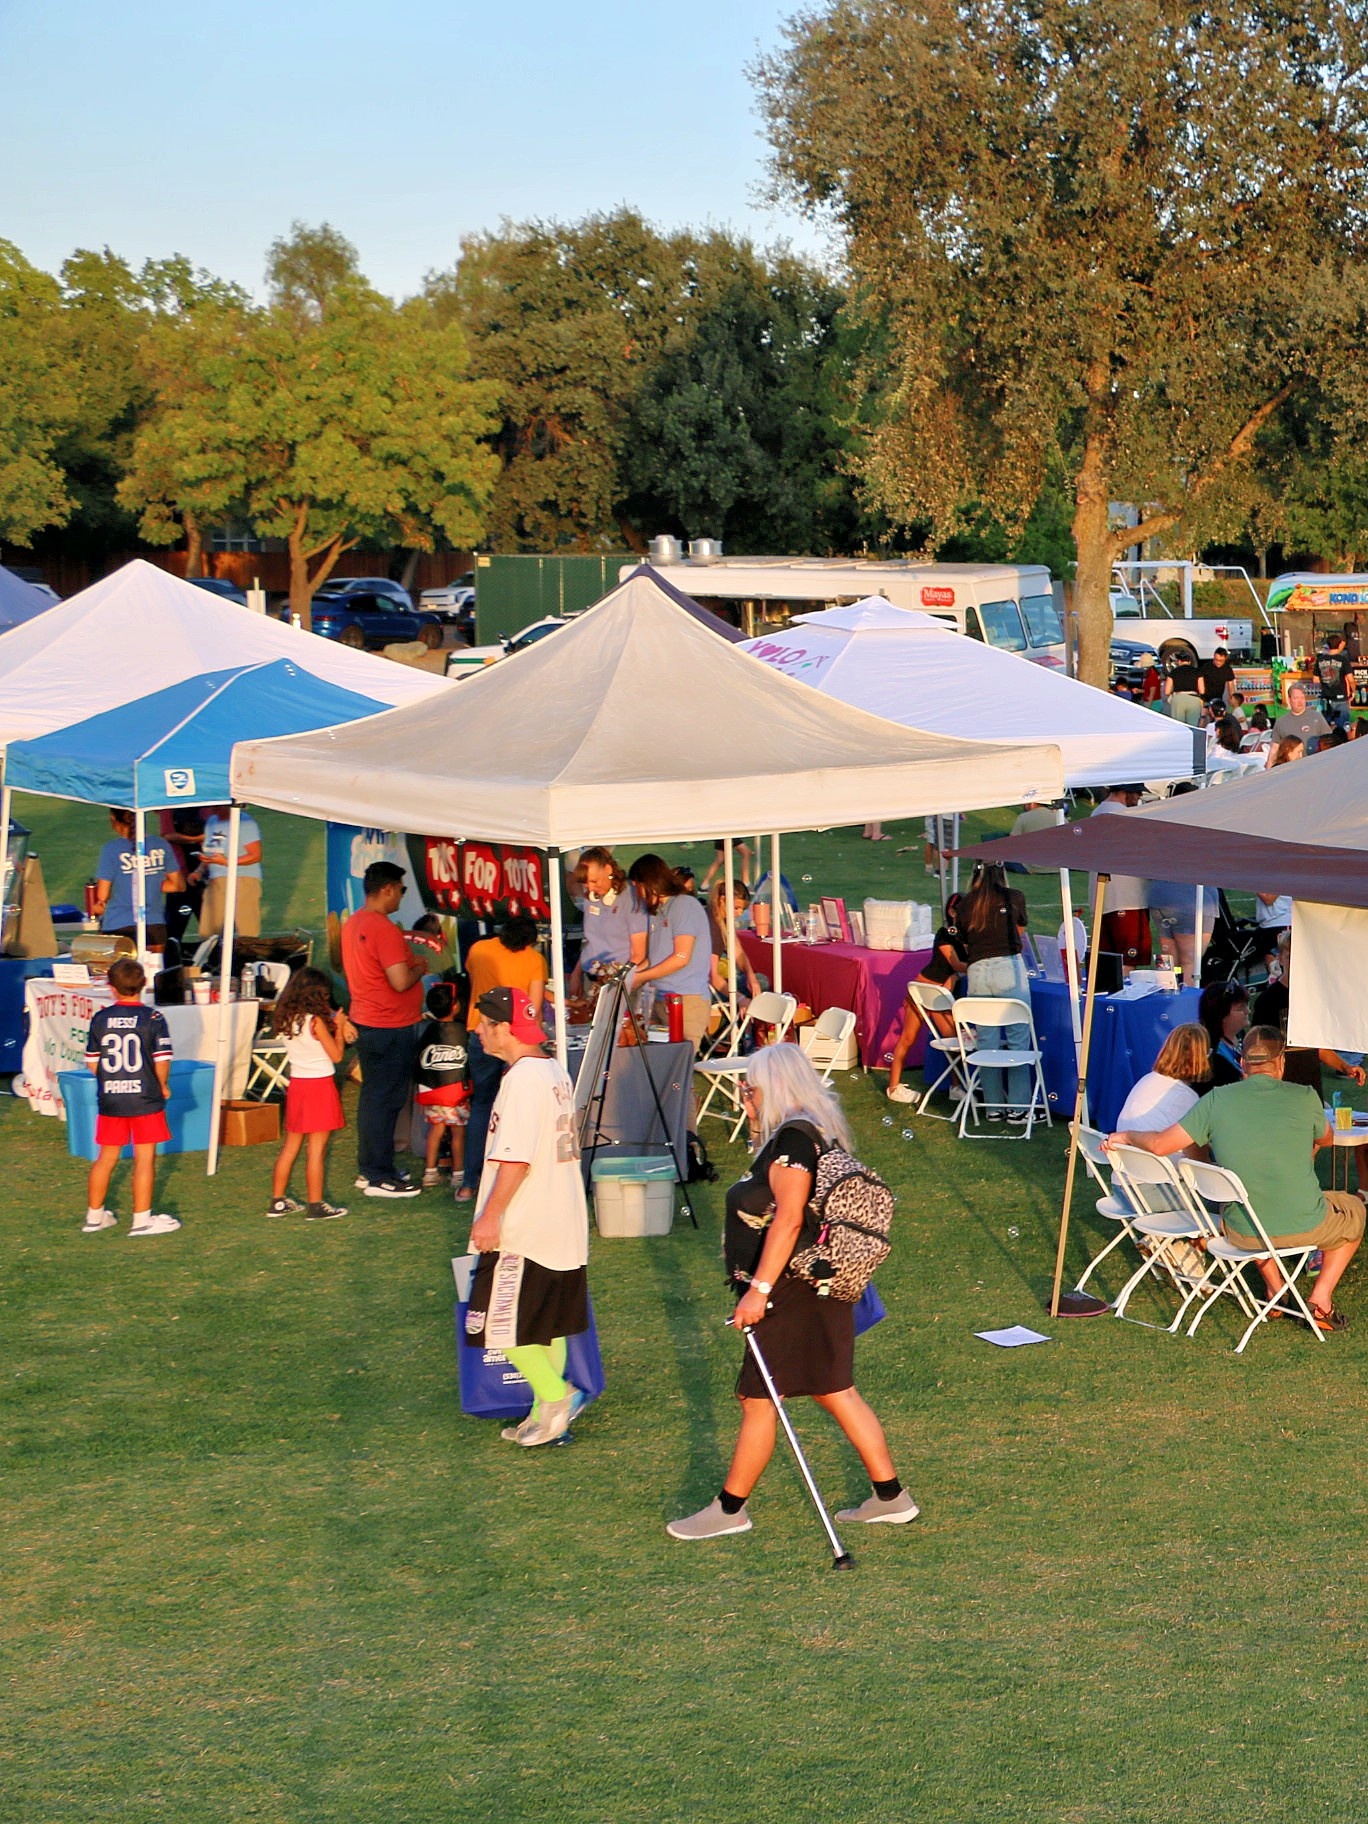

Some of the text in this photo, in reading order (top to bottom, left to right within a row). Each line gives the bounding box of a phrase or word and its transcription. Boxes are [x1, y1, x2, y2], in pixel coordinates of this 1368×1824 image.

[464, 850, 497, 894] FOR
[503, 856, 540, 901] TOTS
[101, 1033, 144, 1073] 30
[104, 1079, 142, 1094] PARIS
